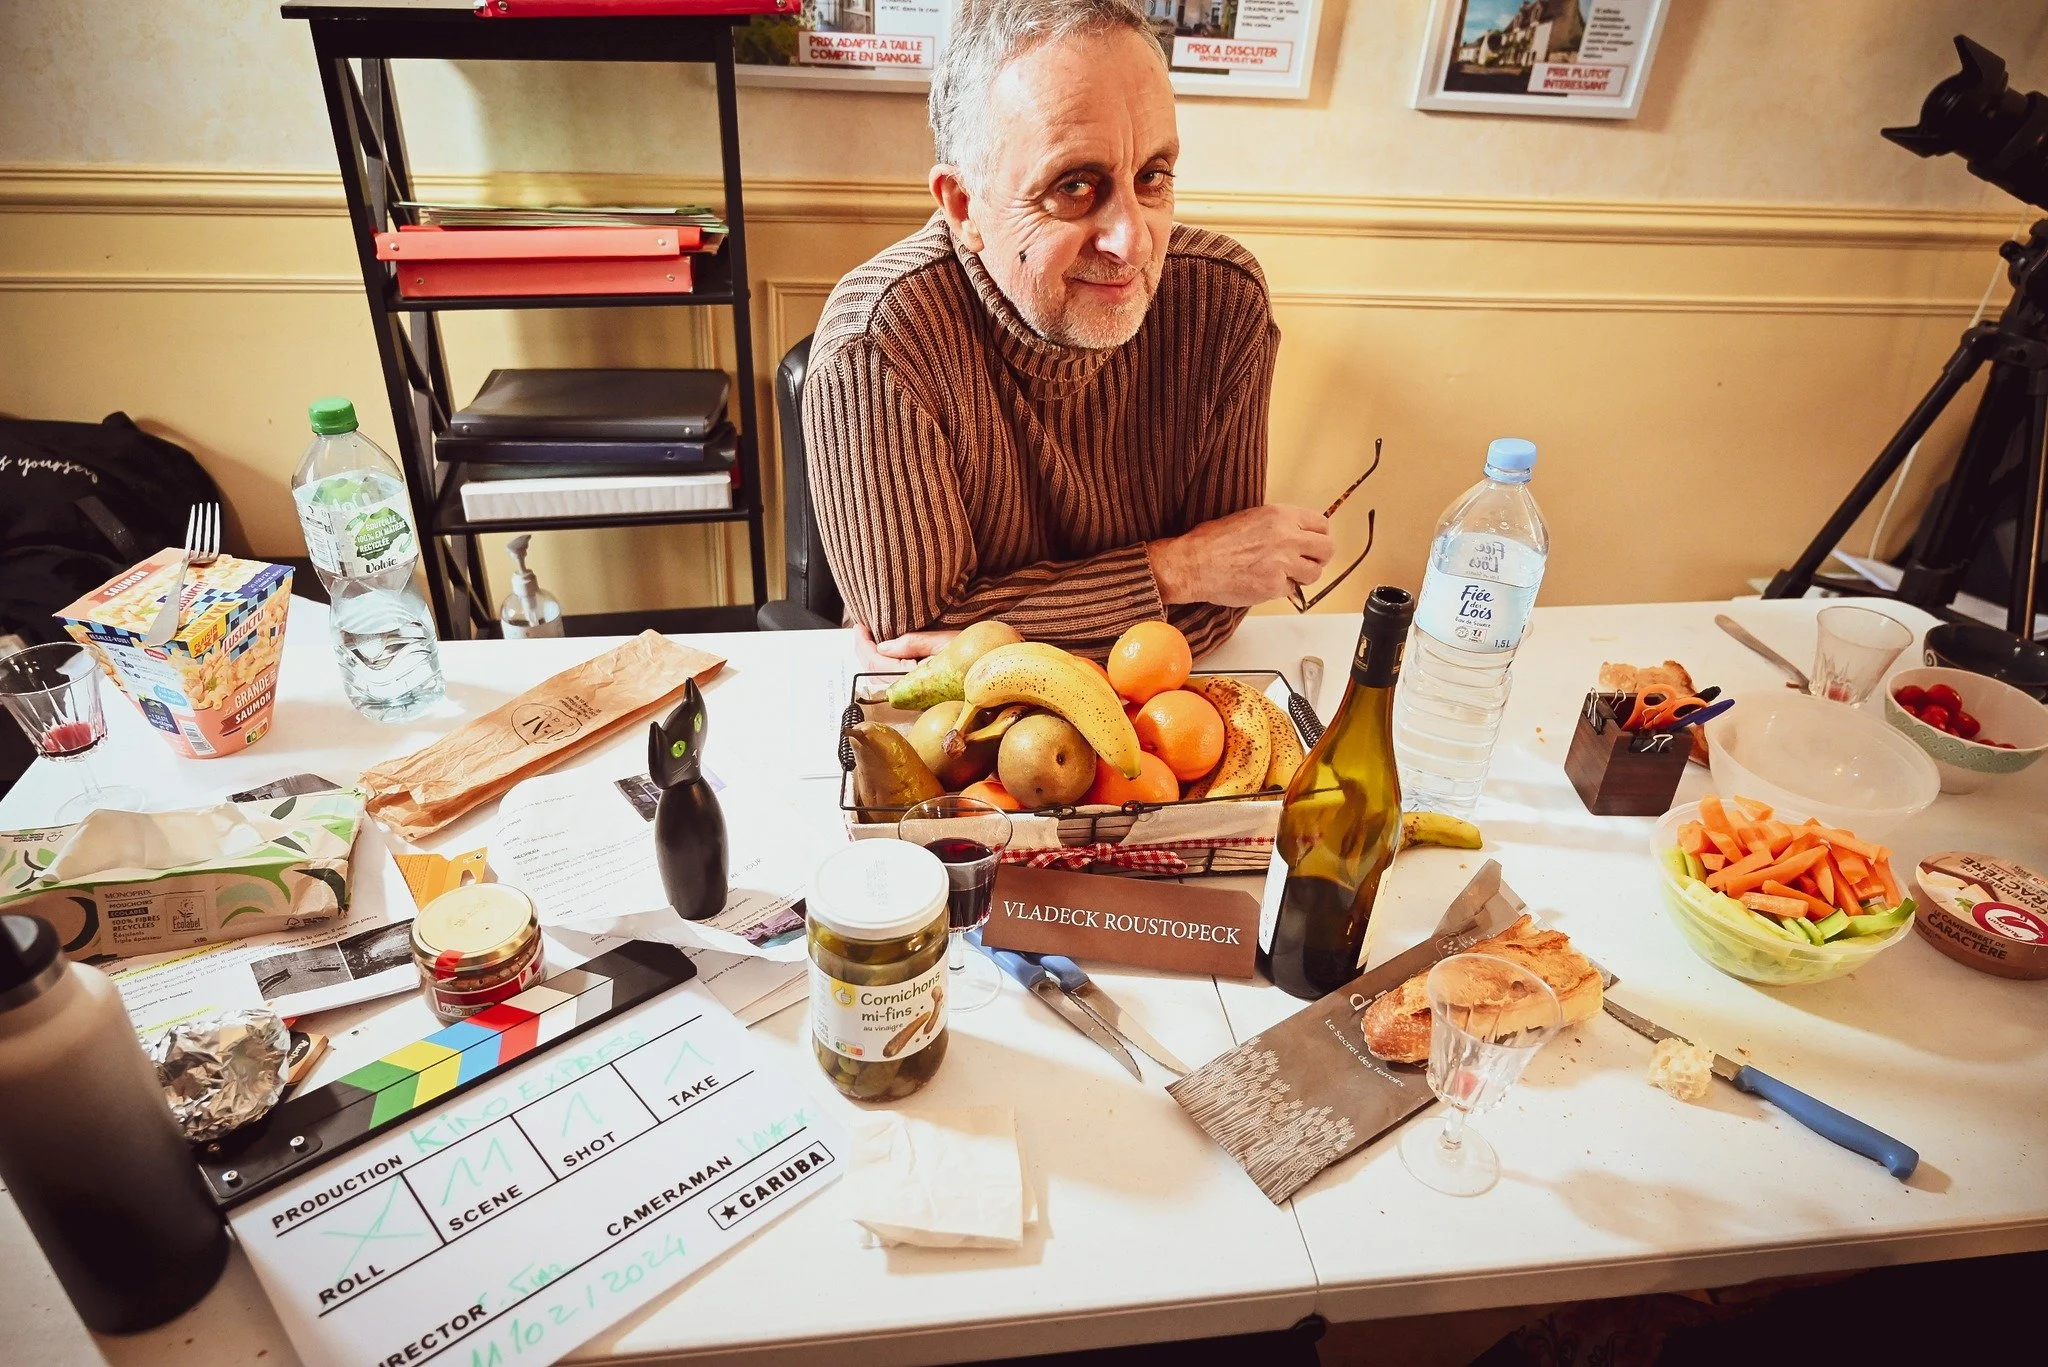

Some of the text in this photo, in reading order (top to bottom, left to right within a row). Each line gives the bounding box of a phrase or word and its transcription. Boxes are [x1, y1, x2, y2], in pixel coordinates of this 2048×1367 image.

[809, 36, 923, 51] PRIX ADAPTE A TAILLE
[1187, 43, 1278, 58] PRIX A DISCUTER
[810, 50, 922, 65] COMPTE EN BANQUE
[1547, 67, 1569, 78] PRIX
[365, 514, 397, 531] BOUTEILLE
[356, 533, 374, 543] 100%
[365, 557, 398, 574] Volvic
[103, 570, 150, 597] SAUMON
[1460, 585, 1495, 602] Fiée
[1459, 600, 1493, 620] Lois
[194, 624, 218, 649] PLAISIR
[224, 608, 264, 654] LUSTUCRU
[234, 674, 270, 708] GRANDE
[235, 692, 272, 724] SAUMON
[104, 889, 152, 899] MONOPRIX
[109, 899, 153, 909] MOUCHOIRS
[110, 907, 148, 917] ECOLABEL
[112, 914, 161, 926] 100% FIBRES
[172, 917, 201, 930] Ecolabel
[1004, 900, 1241, 945] VLADECK ROUSTOPECK
[1941, 913, 1993, 944] CAMEMBERT
[1994, 938, 2007, 949] DE
[861, 970, 941, 1006] Cornichons
[861, 1005, 912, 1024] mi-fins
[863, 1022, 904, 1033] au vinaigre
[517, 1029, 647, 1101] EXPRESS
[1324, 1019, 1406, 1088] Le Secret des Terroirs
[667, 1075, 720, 1107] TAKE
[563, 1131, 617, 1168] SHOT
[271, 1154, 403, 1229] PRODUCTION
[738, 1150, 826, 1209] CARUBA
[448, 1184, 524, 1231] SCENE
[606, 1155, 733, 1237] CAMERAMAN
[318, 1264, 386, 1306] ROLL
